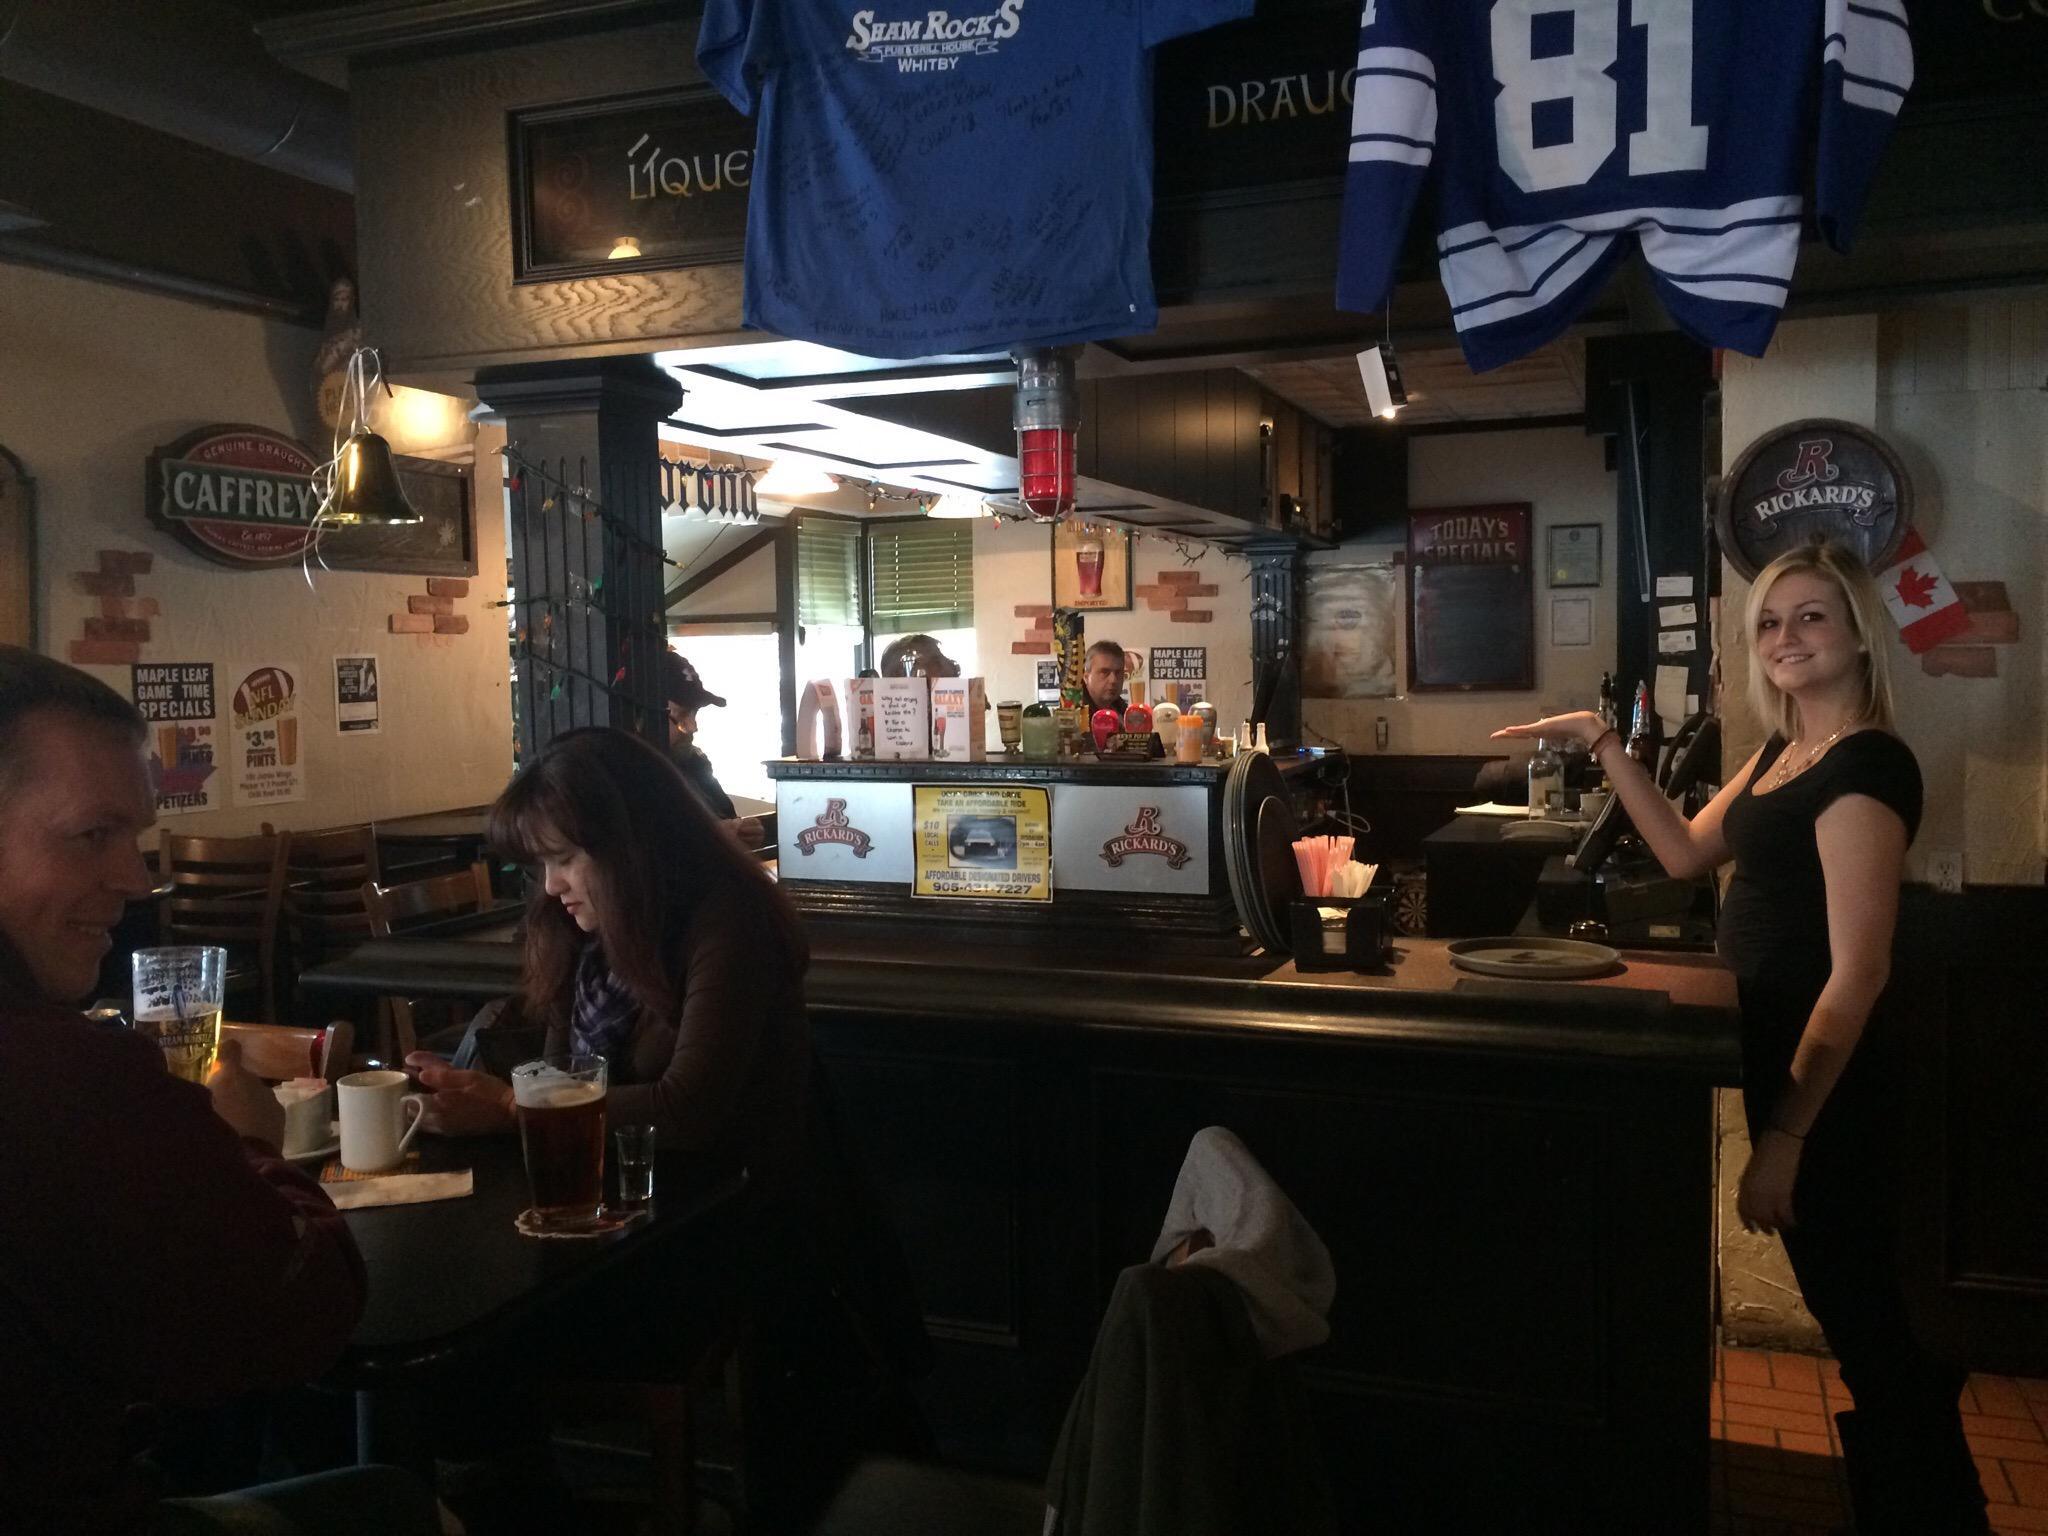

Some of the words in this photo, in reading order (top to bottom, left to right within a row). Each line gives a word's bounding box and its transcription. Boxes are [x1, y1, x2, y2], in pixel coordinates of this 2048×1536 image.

[1490, 0, 1709, 194] 81
[627, 133, 757, 200] LIQUE
[203, 441, 253, 460] GENUINE
[258, 443, 308, 473] DRAUGHT
[658, 457, 758, 520] orona
[1754, 485, 1877, 521] RICKARD'S
[1430, 516, 1509, 541] TODAY'S
[1423, 541, 1519, 560] SPECIALS
[1153, 649, 1182, 659] MAPLE
[1183, 649, 1204, 659] LEAF
[1153, 658, 1177, 668] GAME
[1183, 658, 1203, 668] TIME
[137, 668, 179, 684] MAPLE
[182, 667, 209, 683] LEAF
[1153, 668, 1203, 678] SPECIALS
[138, 685, 173, 700] GAME
[182, 684, 210, 699] TIME
[138, 700, 211, 719] SPECIALS
[246, 753, 276, 768] PINTS
[156, 792, 208, 810] PETIZERS
[937, 799, 954, 807] TAKE
[965, 799, 1009, 808] AFFORDABLE
[1010, 800, 1027, 808] RIDE
[923, 820, 940, 830] $10
[804, 828, 863, 846] RICKARD'S
[1111, 838, 1178, 856] RICKARD'S
[925, 870, 967, 881] AFFORDABLE
[969, 871, 1010, 882] DESIGNATED
[1011, 873, 1042, 884] DRIVERS
